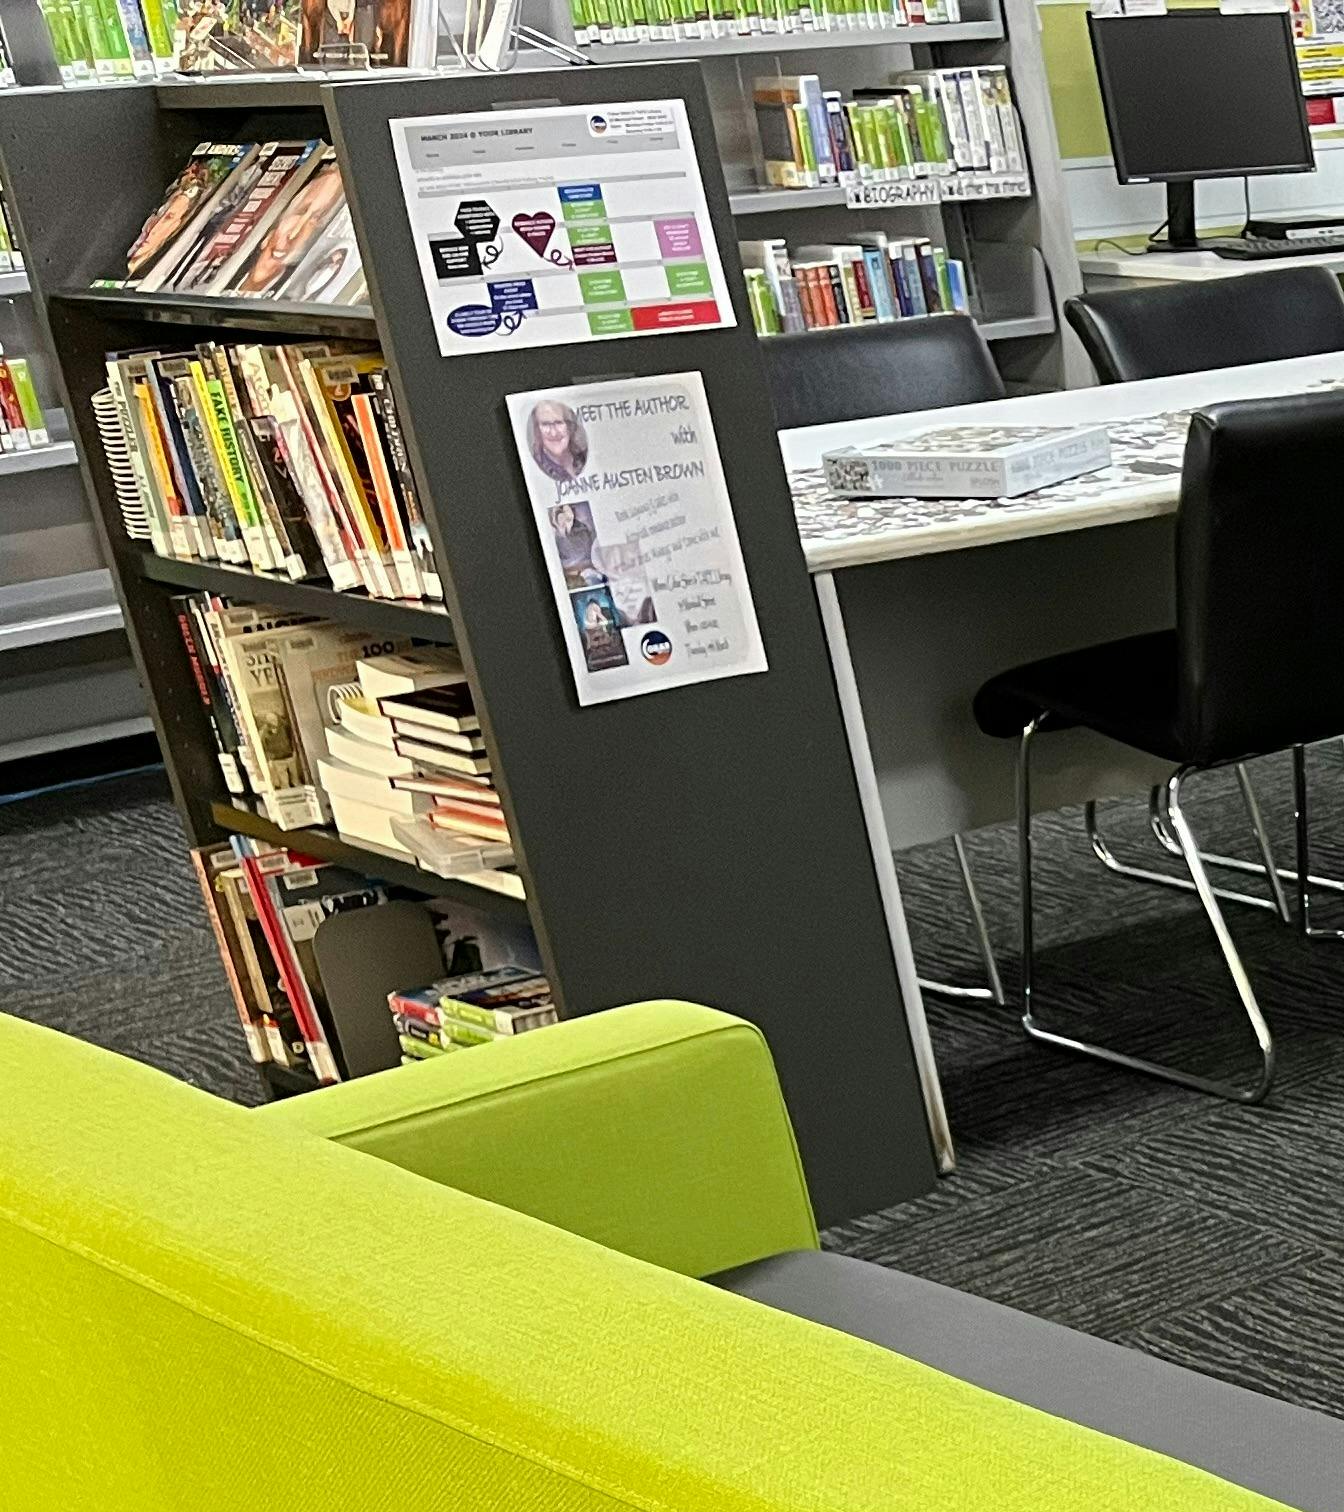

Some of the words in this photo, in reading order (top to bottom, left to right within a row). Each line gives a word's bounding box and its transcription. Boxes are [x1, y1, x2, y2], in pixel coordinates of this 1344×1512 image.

[501, 128, 533, 136] LIBRARY
[864, 184, 935, 203] BIOGRAPHY
[607, 399, 631, 420] THE
[634, 395, 690, 416] AUTHOR
[209, 392, 231, 427] FAKE
[220, 428, 245, 483] HISTORY
[670, 425, 698, 446] with
[872, 460, 900, 471] 1000
[907, 461, 942, 471] PIECE
[950, 461, 1000, 472] PUZZLE
[555, 475, 601, 503] JOANNE
[603, 465, 653, 489] AUSTEN
[656, 460, 705, 479] BROWN
[362, 640, 395, 657] 100
